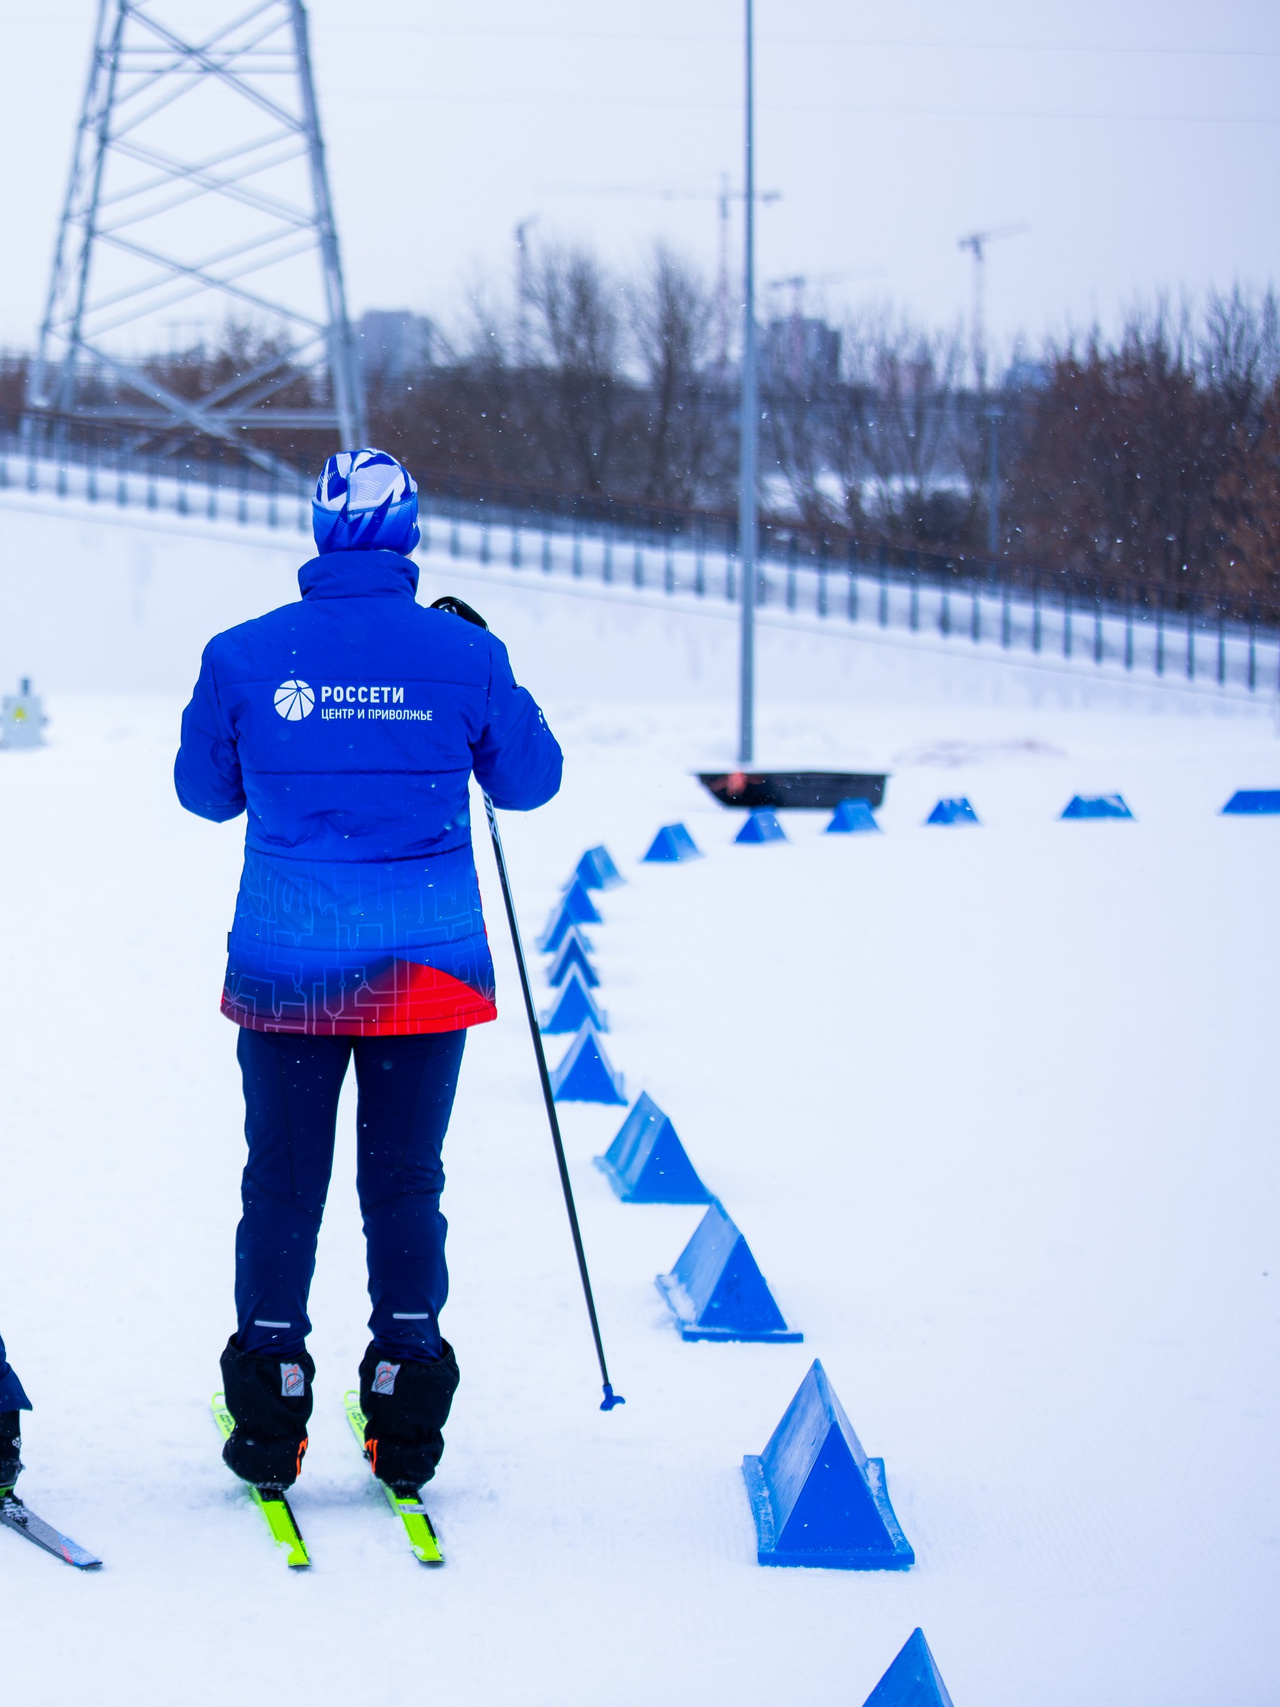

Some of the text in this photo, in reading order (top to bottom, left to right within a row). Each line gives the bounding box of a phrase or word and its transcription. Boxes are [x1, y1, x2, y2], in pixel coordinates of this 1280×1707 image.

[321, 686, 404, 704] РОССЕТИ
[321, 708, 433, 721] ЦЕНТР И ПРИВОЛЖЬЕ
